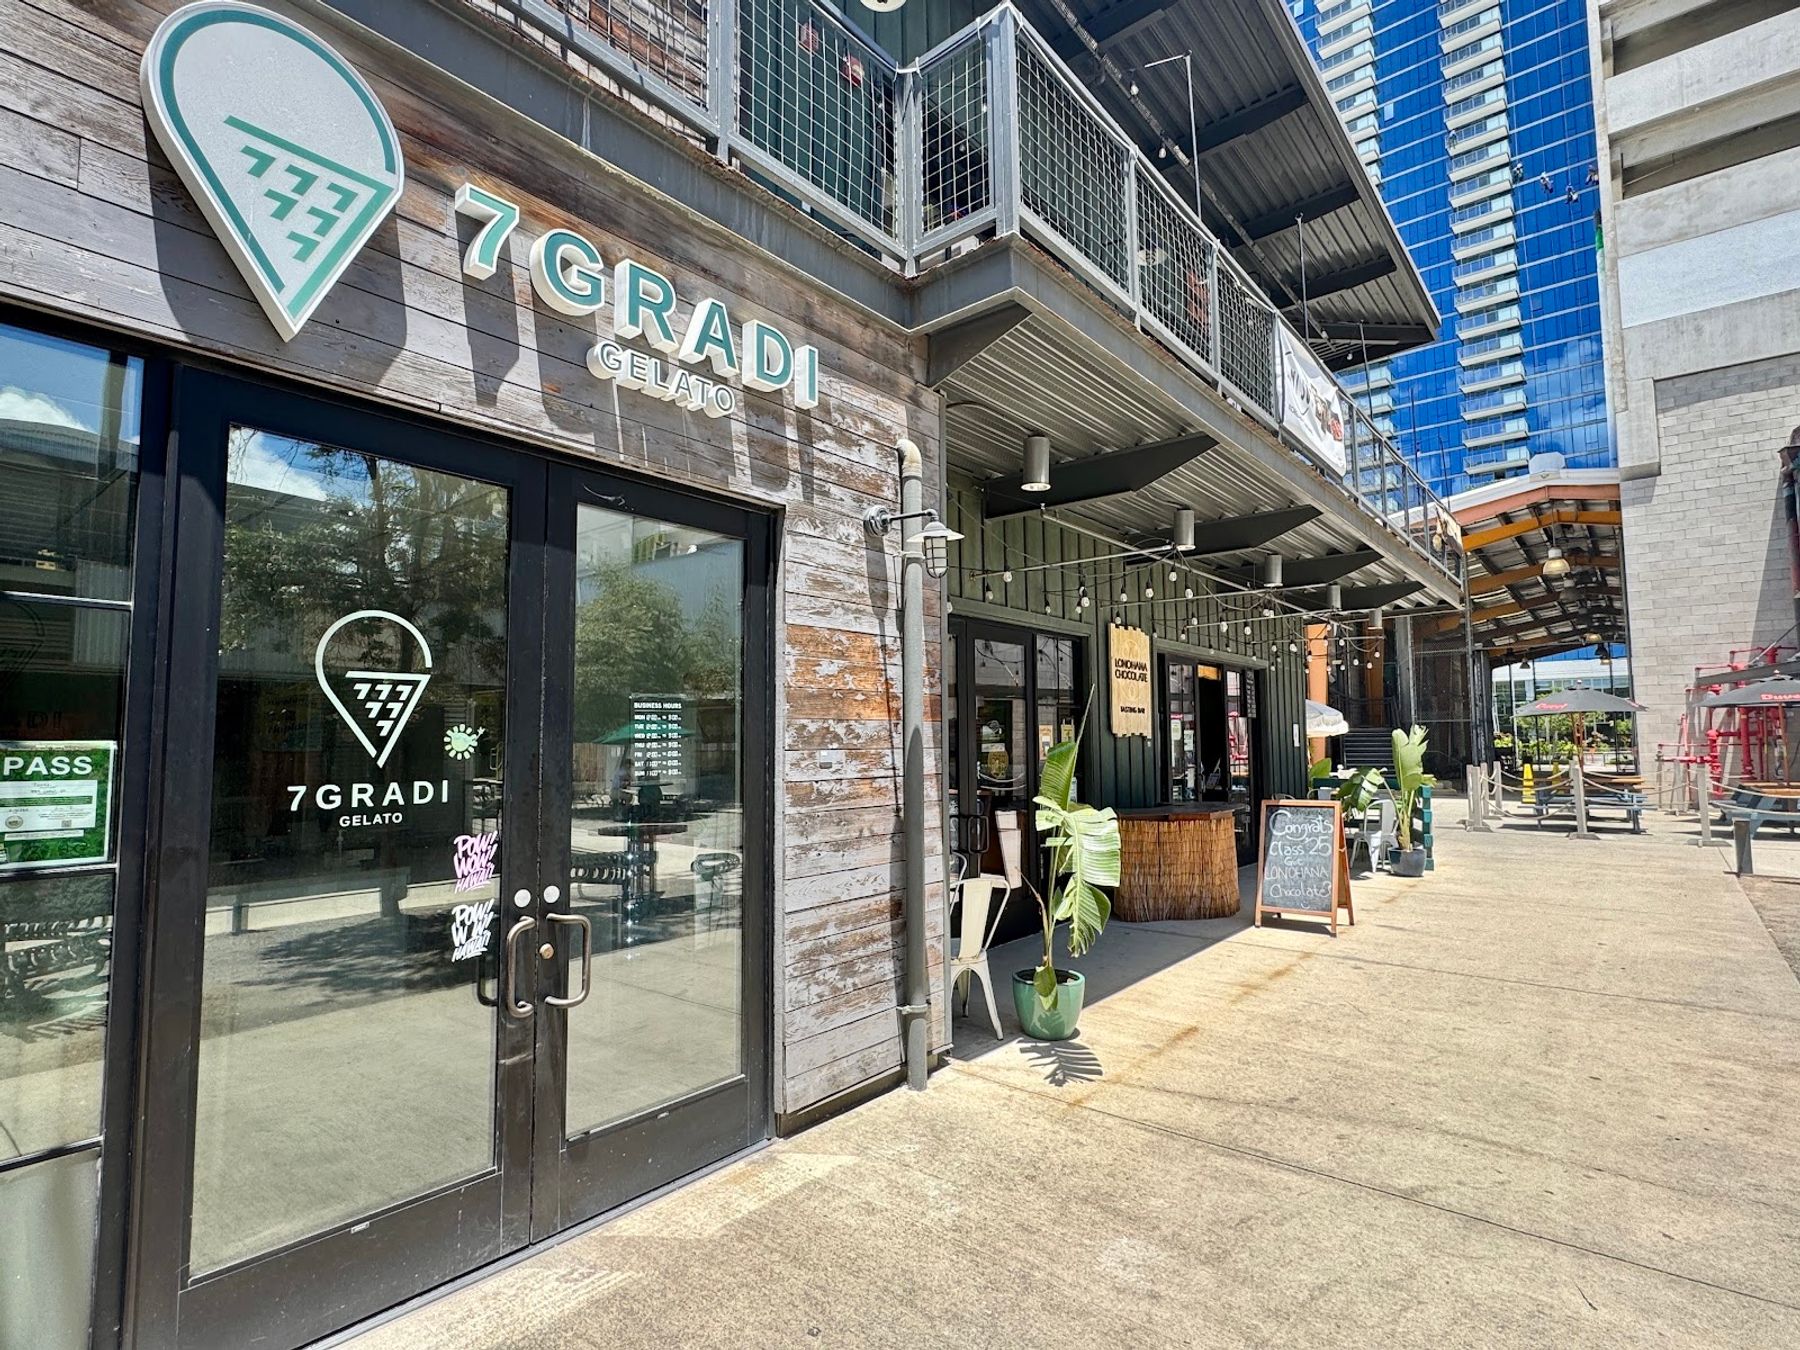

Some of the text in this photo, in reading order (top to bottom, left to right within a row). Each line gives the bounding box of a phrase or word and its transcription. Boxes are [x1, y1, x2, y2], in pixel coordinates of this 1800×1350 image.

[588, 340, 735, 418] GELATO
[1114, 669, 1148, 682] CHOCOLATE
[3, 756, 93, 776] PASS
[339, 812, 403, 827] GELATO
[1269, 809, 1334, 841] Congrats
[453, 830, 498, 859] POW!
[1269, 840, 1304, 857] Class
[1264, 865, 1329, 880] LONOHANA
[451, 898, 495, 929] POW!
